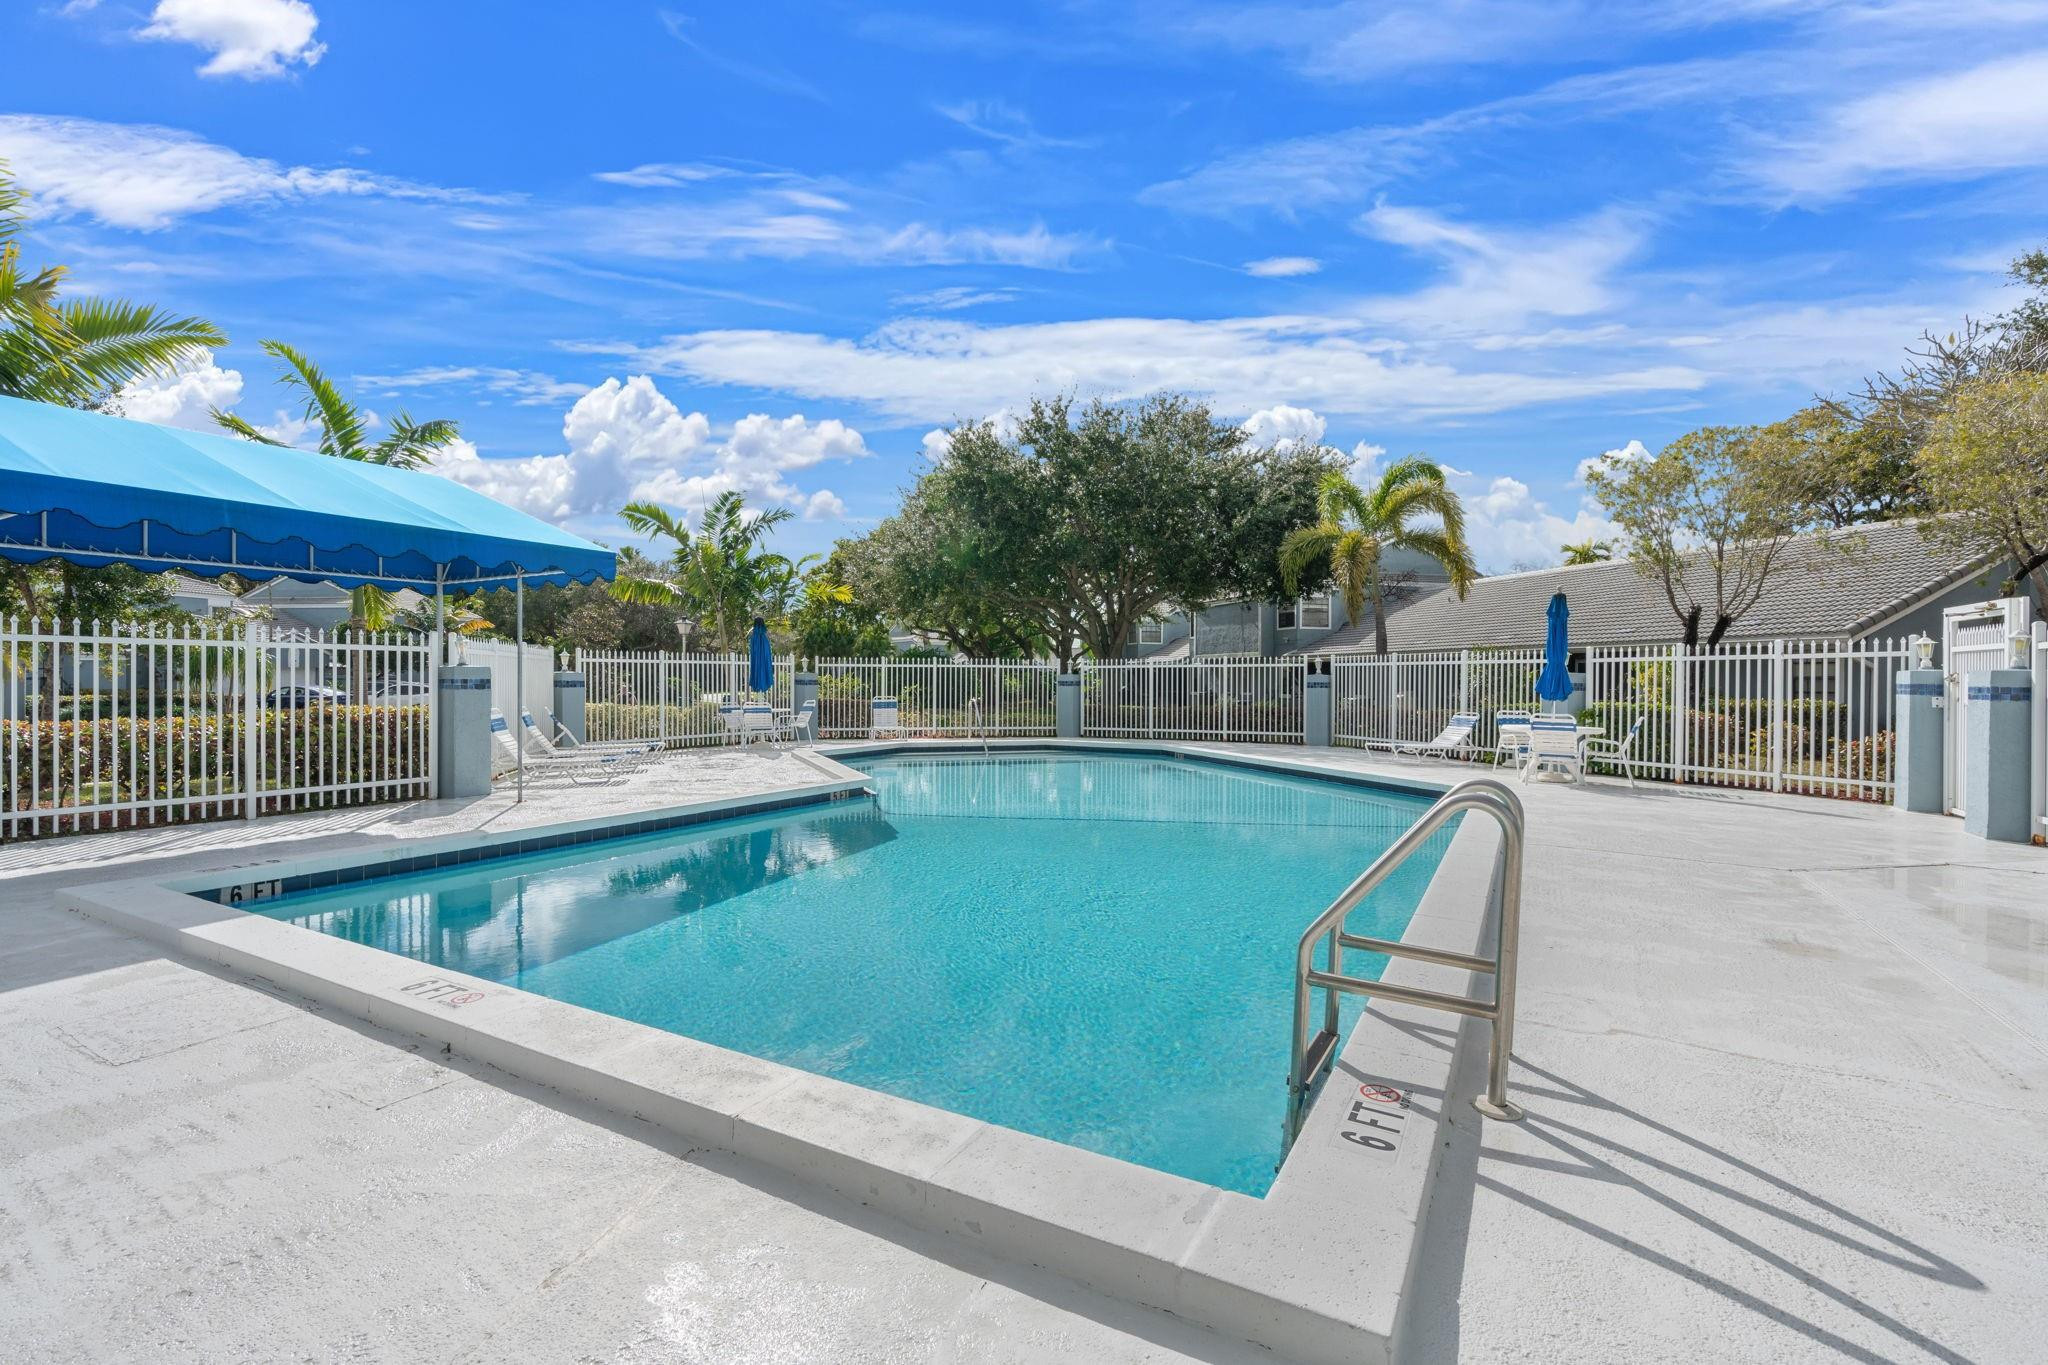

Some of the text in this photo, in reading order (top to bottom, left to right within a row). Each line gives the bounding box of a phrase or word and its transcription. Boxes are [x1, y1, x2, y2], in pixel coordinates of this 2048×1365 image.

[230, 879, 280, 902] 6 FT
[400, 980, 468, 1000] 6 FT
[1340, 1101, 1404, 1151] 6 FT
